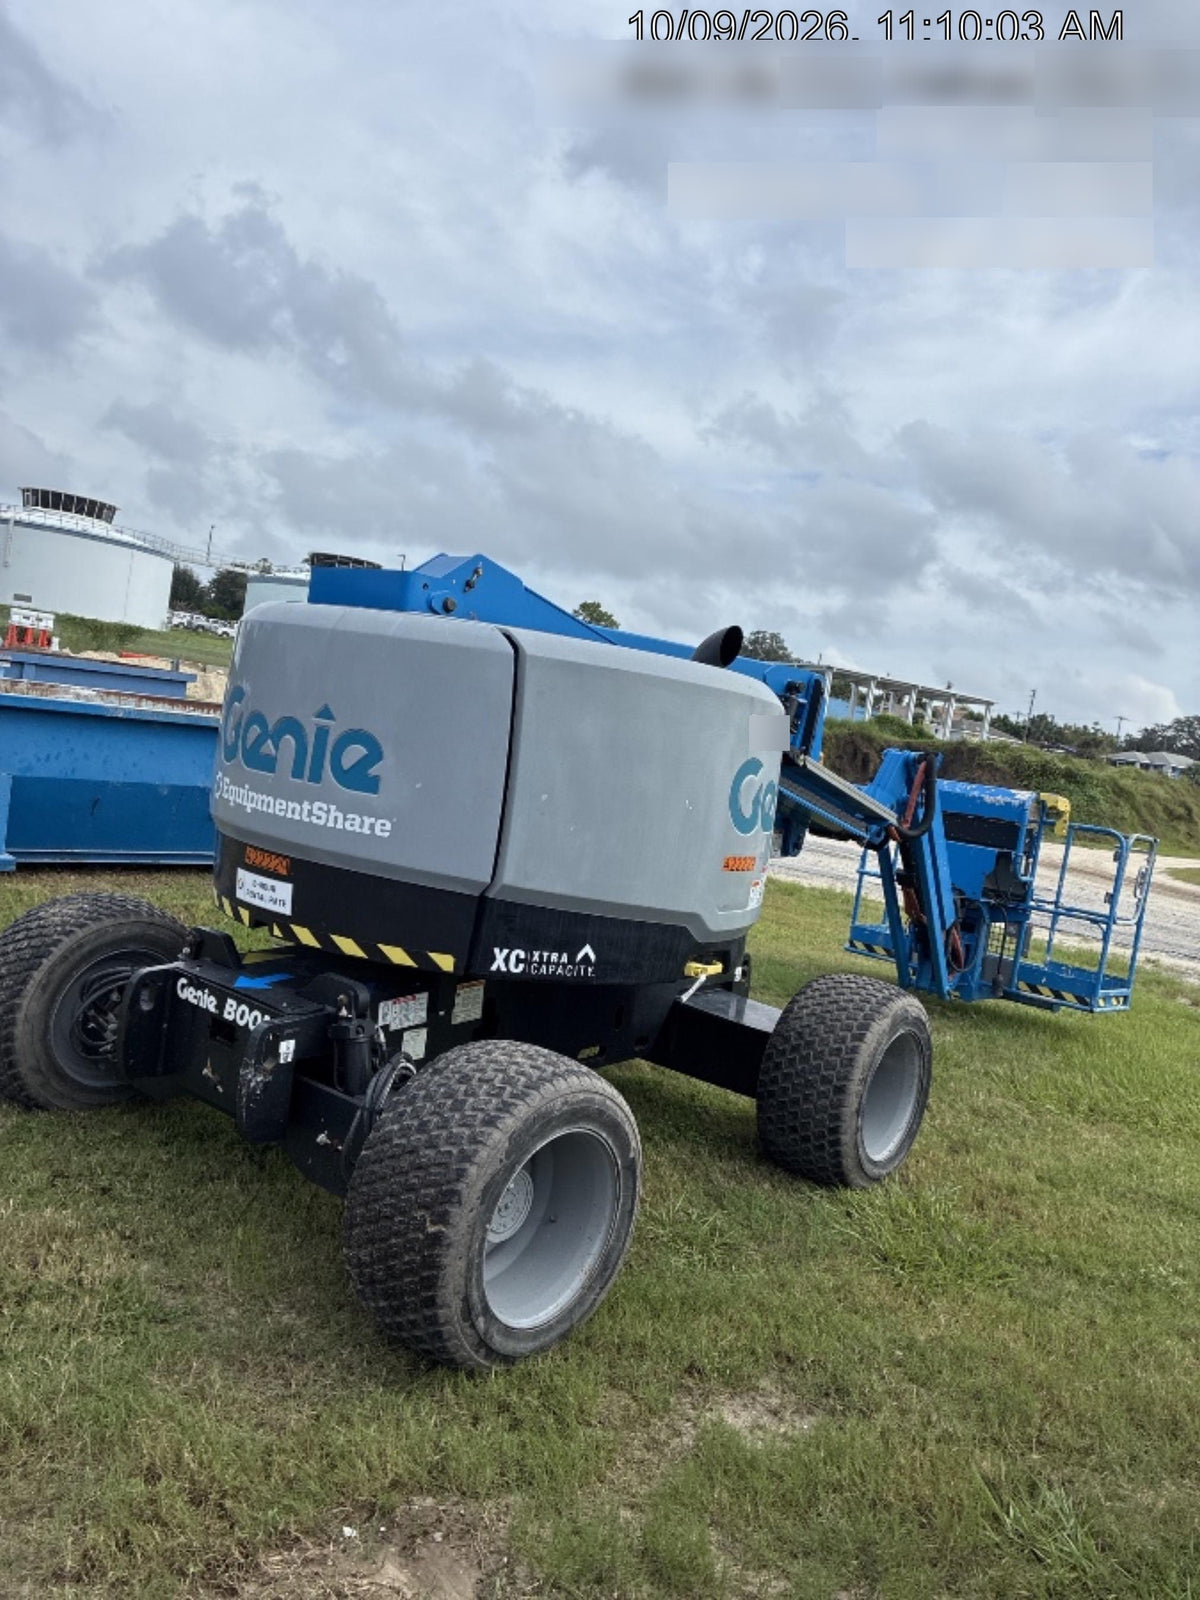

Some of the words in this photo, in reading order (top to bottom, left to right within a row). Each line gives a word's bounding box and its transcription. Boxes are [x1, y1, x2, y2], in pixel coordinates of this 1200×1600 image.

[223, 685, 384, 797] Genie
[222, 777, 393, 838] EquipmentShare
[489, 946, 526, 974] XC
[531, 950, 569, 964] XTRA
[176, 977, 219, 1014] Genie
